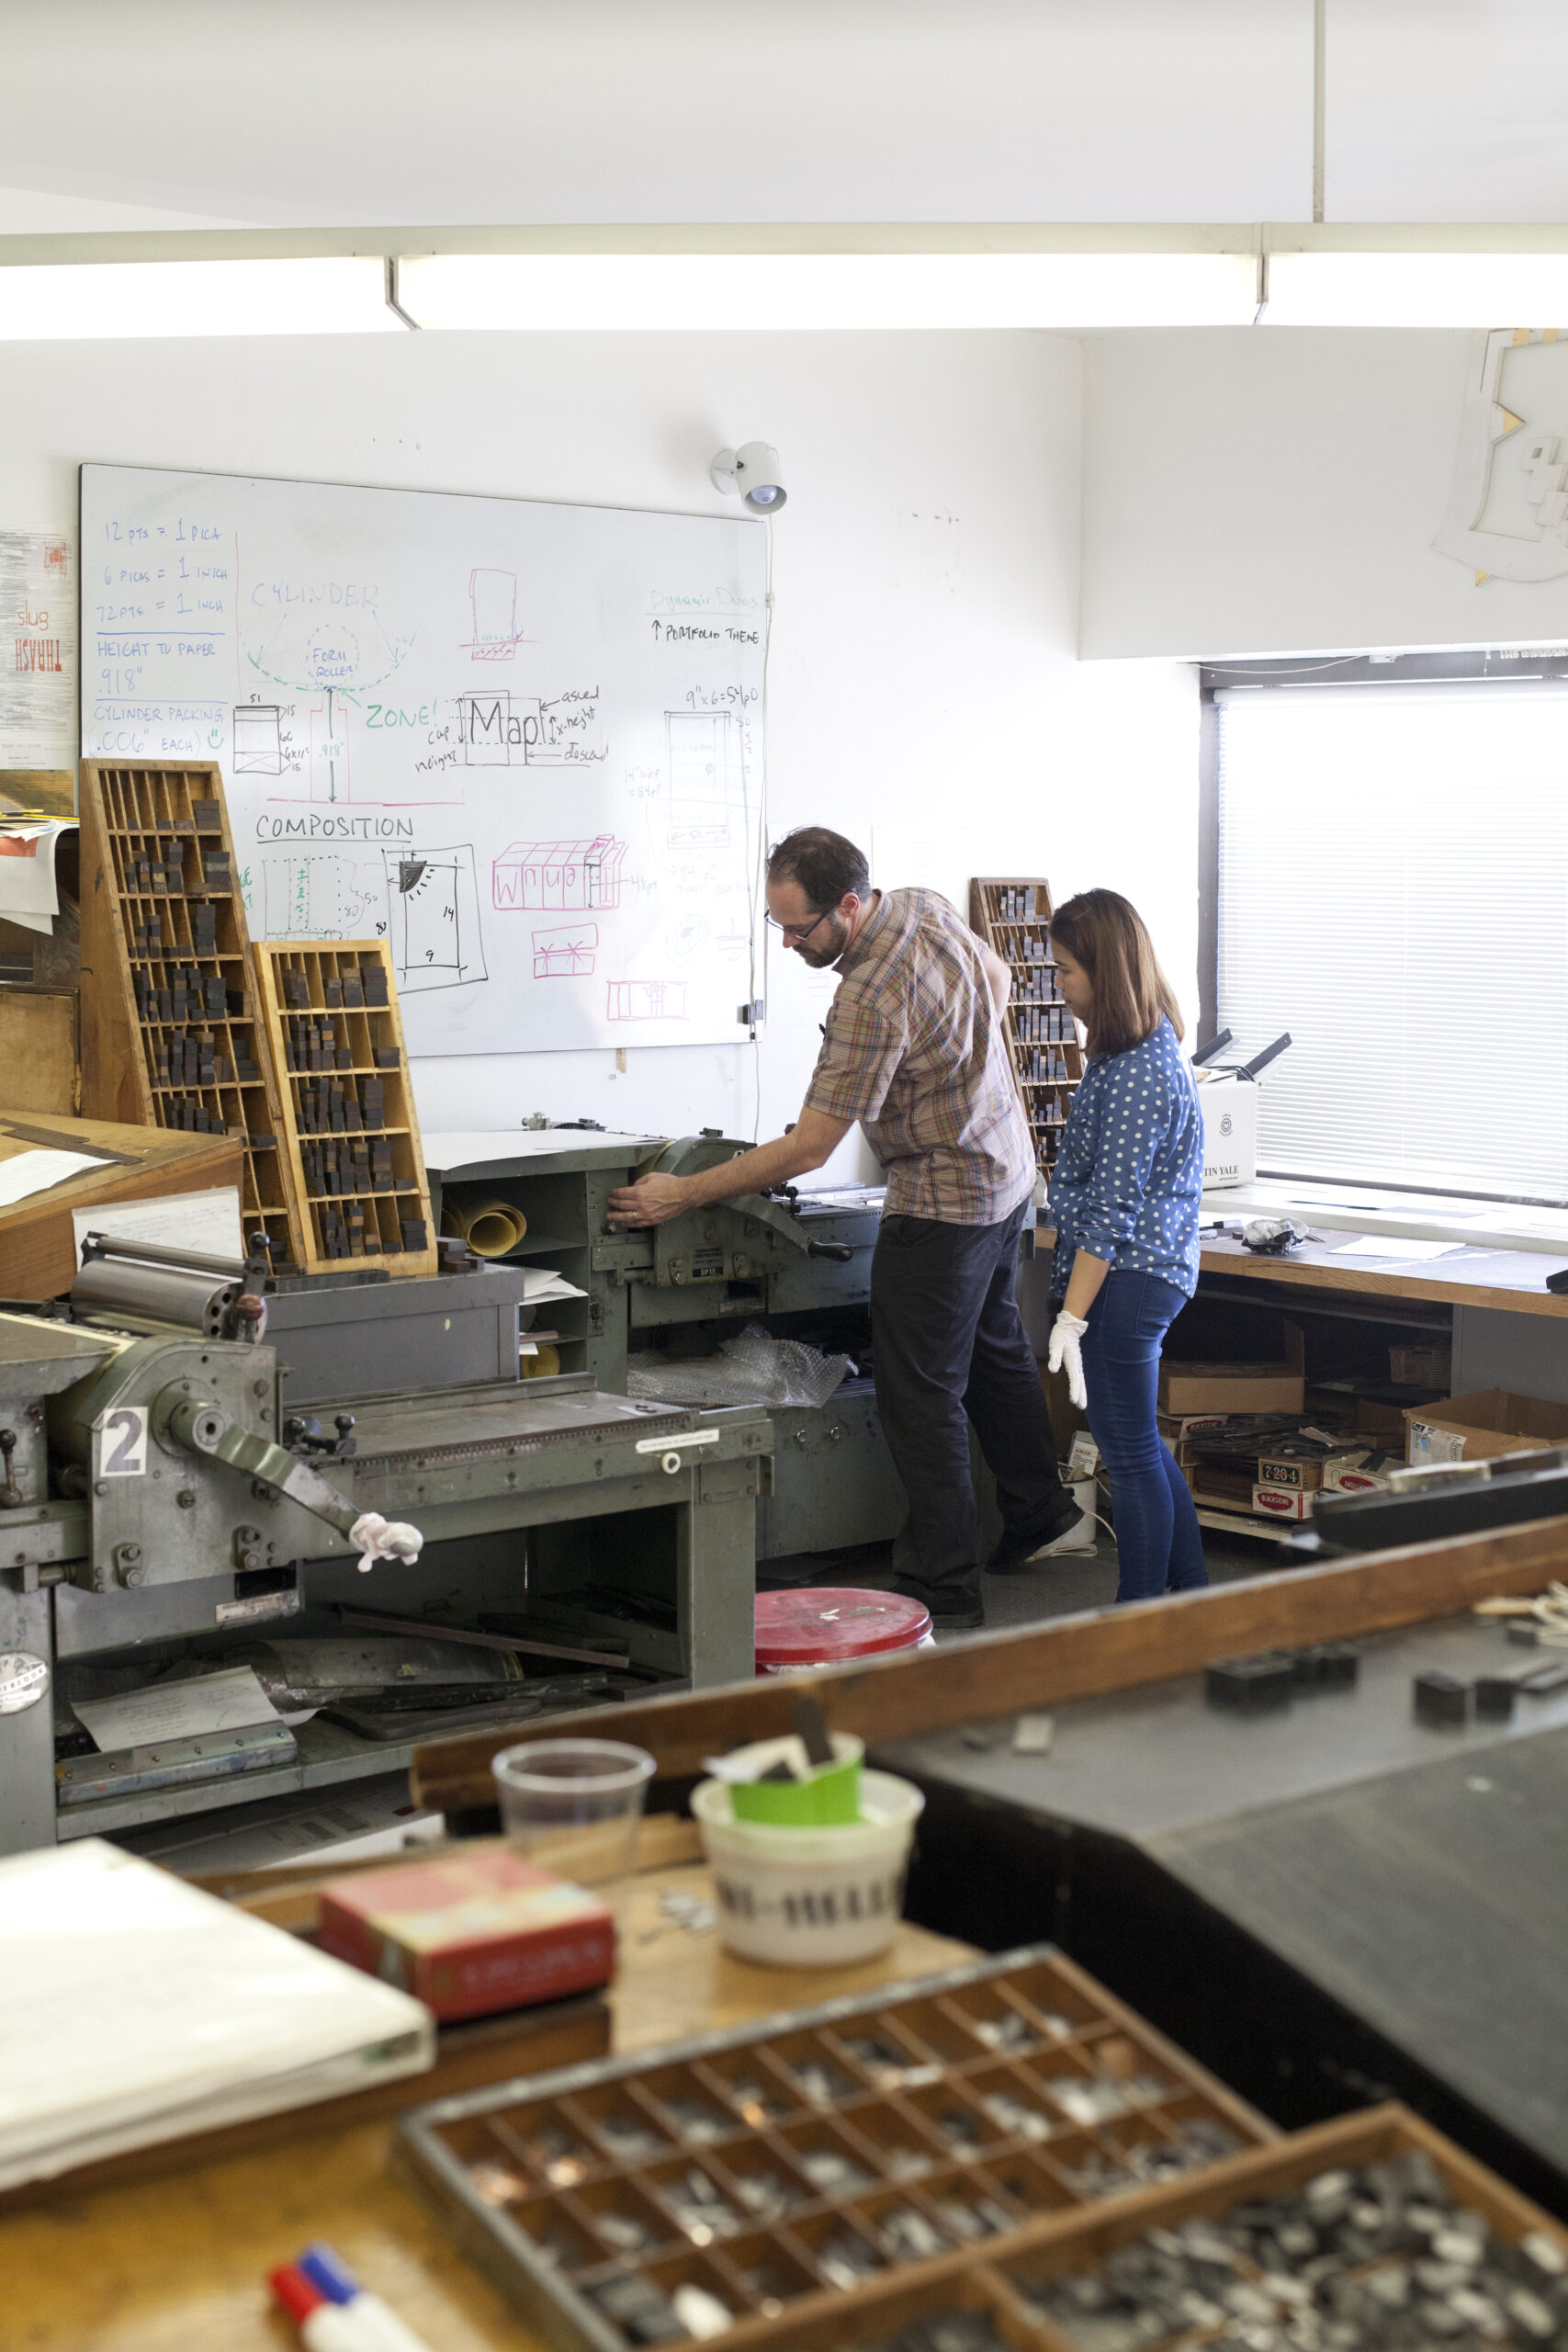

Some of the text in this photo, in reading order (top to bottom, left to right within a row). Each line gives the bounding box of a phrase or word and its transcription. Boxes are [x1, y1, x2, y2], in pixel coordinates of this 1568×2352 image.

[106, 521, 124, 543] 12
[175, 517, 186, 541] 1
[191, 526, 221, 542] PICA
[104, 565, 112, 585] 6
[120, 570, 151, 583] PICAS
[178, 556, 191, 579] 1
[176, 593, 194, 615] 1
[197, 598, 224, 613] INCH
[252, 582, 380, 610] CYLINDER
[17, 597, 50, 631] slug
[14, 639, 62, 673] THRASH
[96, 640, 217, 659] HEIGHT TO PAPER
[94, 705, 225, 724] CYLINDER PACKING
[366, 697, 439, 729] ZONE!
[470, 699, 539, 765] Map
[255, 814, 414, 839] COMPOSITION
[443, 906, 456, 922] 14
[425, 949, 435, 963] 9
[1203, 1165, 1239, 1177] TIN YALE
[106, 1410, 141, 1474] 2
[1261, 1494, 1290, 1506] BLACKSTONE
